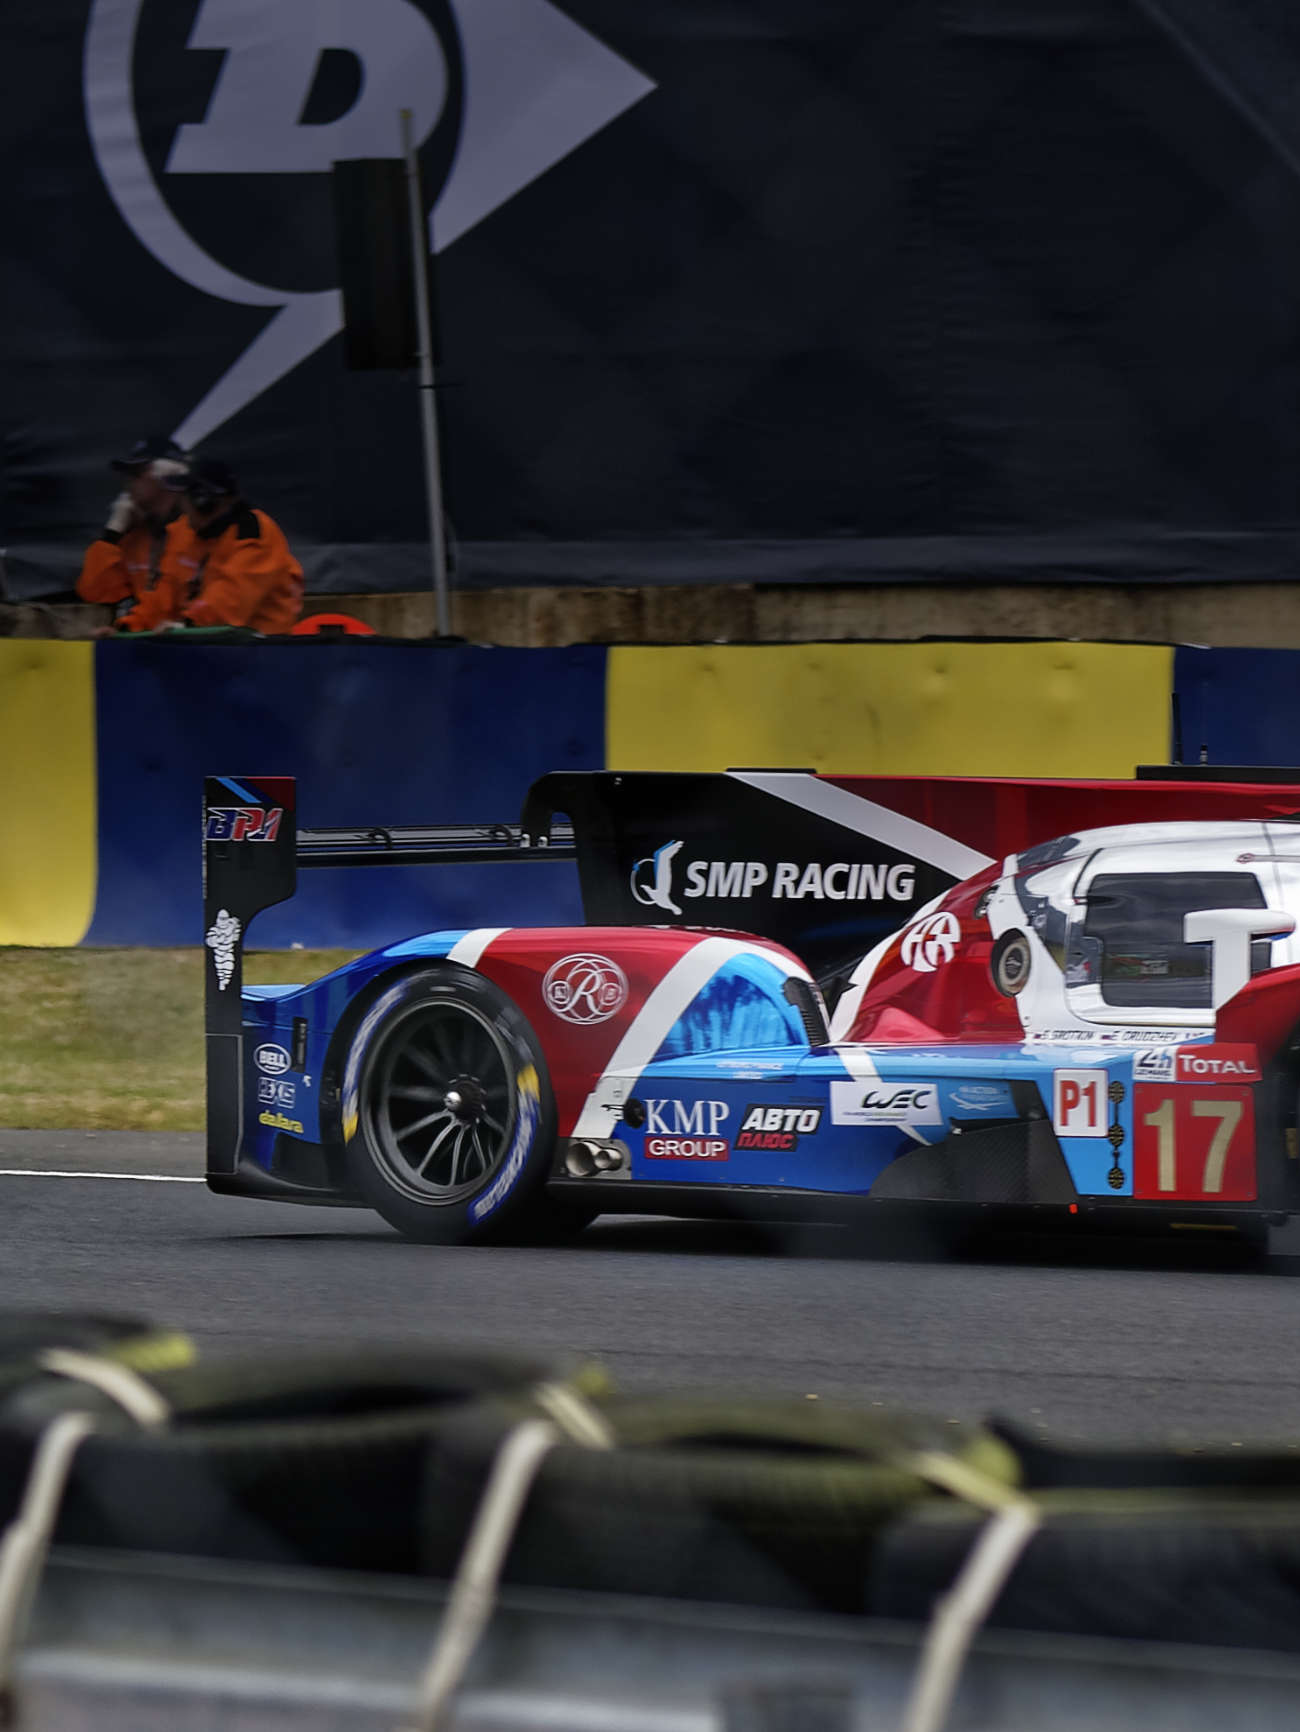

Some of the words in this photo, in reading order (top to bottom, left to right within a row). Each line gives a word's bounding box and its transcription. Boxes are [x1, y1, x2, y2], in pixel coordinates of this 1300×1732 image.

[684, 860, 768, 899] SMP
[772, 862, 916, 901] RACING
[259, 1050, 288, 1068] BELL
[1179, 1054, 1257, 1074] TOTAL
[861, 1089, 932, 1110] WEC
[1059, 1080, 1097, 1127] P1
[644, 1099, 730, 1136] KMP
[741, 1107, 821, 1132] АВТО
[648, 1139, 726, 1158] GROUP
[1143, 1099, 1244, 1193] 17
